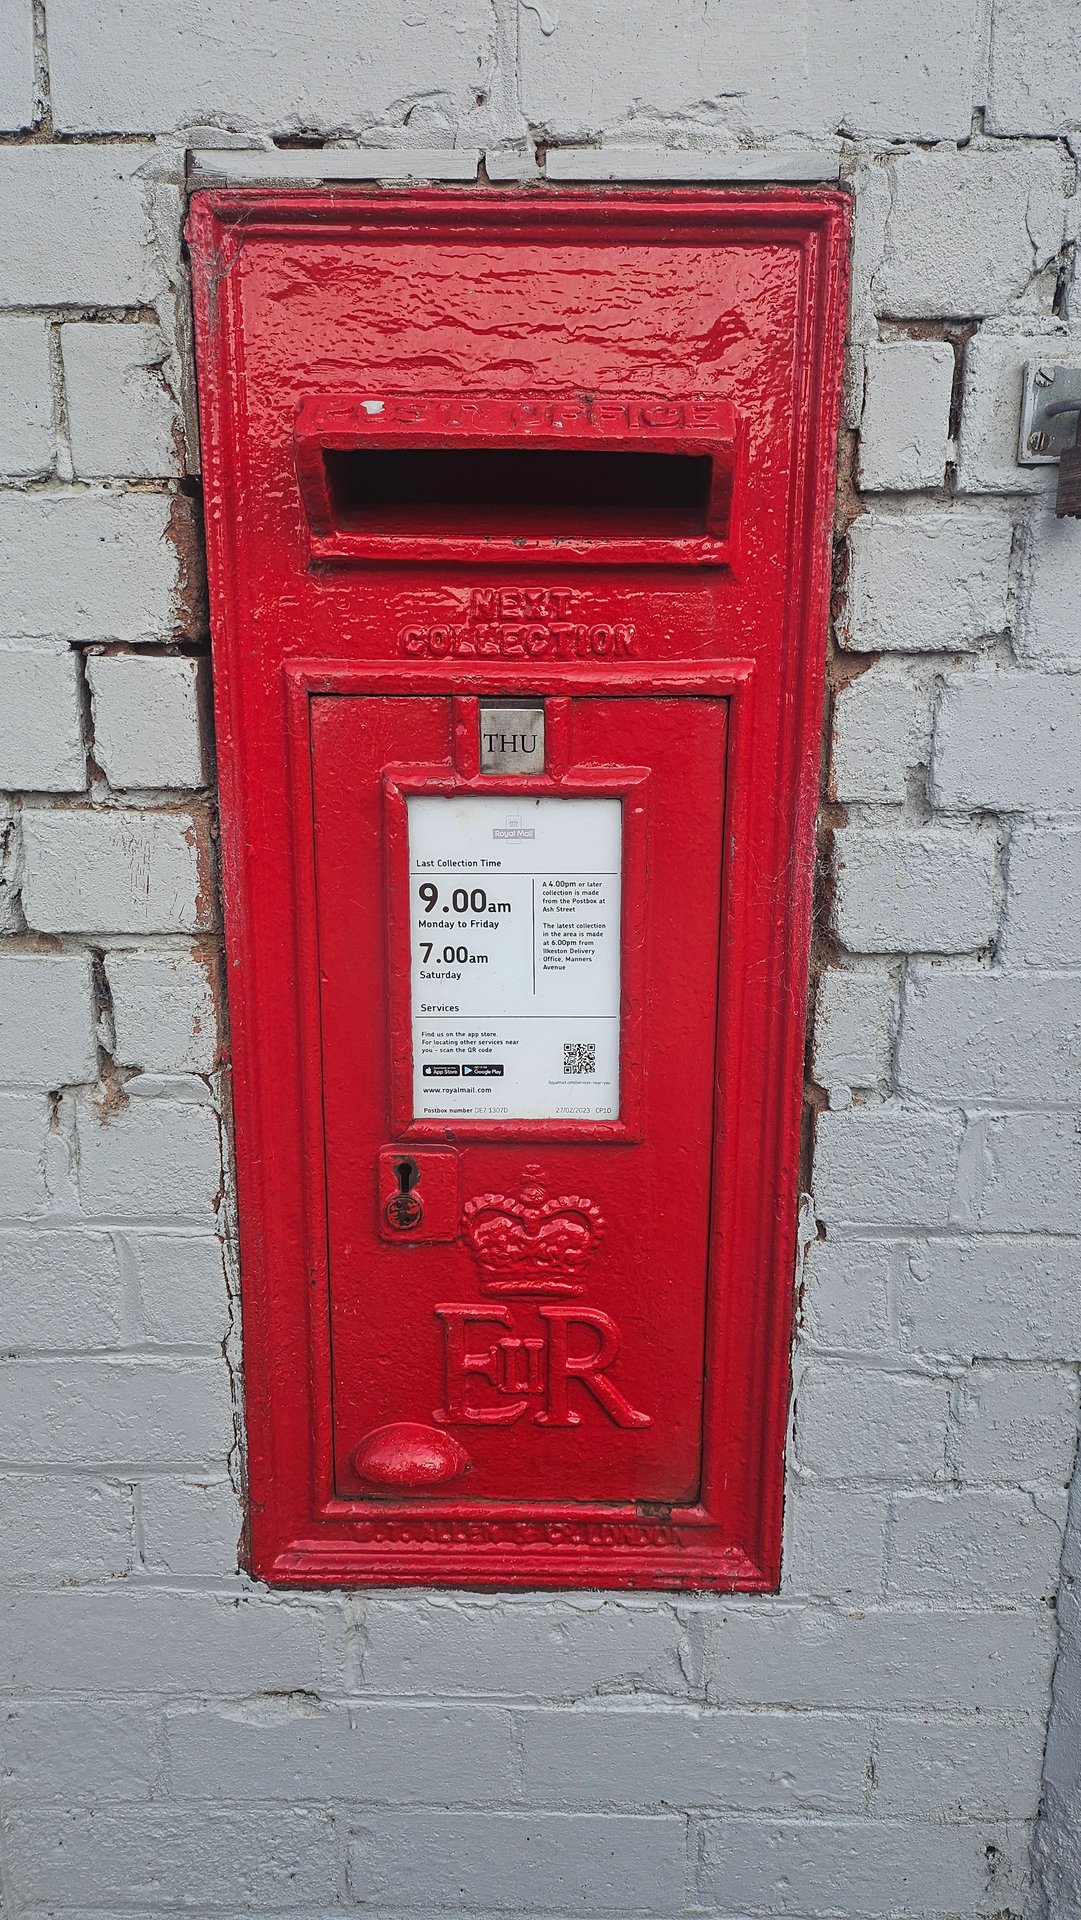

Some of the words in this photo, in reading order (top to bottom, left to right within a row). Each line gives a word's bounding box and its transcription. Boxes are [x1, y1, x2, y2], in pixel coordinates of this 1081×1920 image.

[508, 404, 723, 431] OFFICE
[470, 587, 574, 620] NEXT
[397, 623, 637, 657] COLLECTION
[483, 733, 538, 753] THU
[494, 830, 515, 838] Royal
[516, 829, 534, 837] Mail
[416, 860, 434, 868] Last
[437, 860, 478, 868] Collection
[480, 860, 501, 868] Time
[549, 880, 576, 888] 4.00pm
[419, 883, 511, 913] 9.00am
[418, 920, 455, 930] Monday
[458, 920, 467, 928] to
[471, 920, 499, 930] Friday
[419, 943, 488, 963] 7.00am
[420, 970, 462, 980] Saturday
[420, 1004, 460, 1012] Services
[588, 1523, 685, 1547] LONDON
